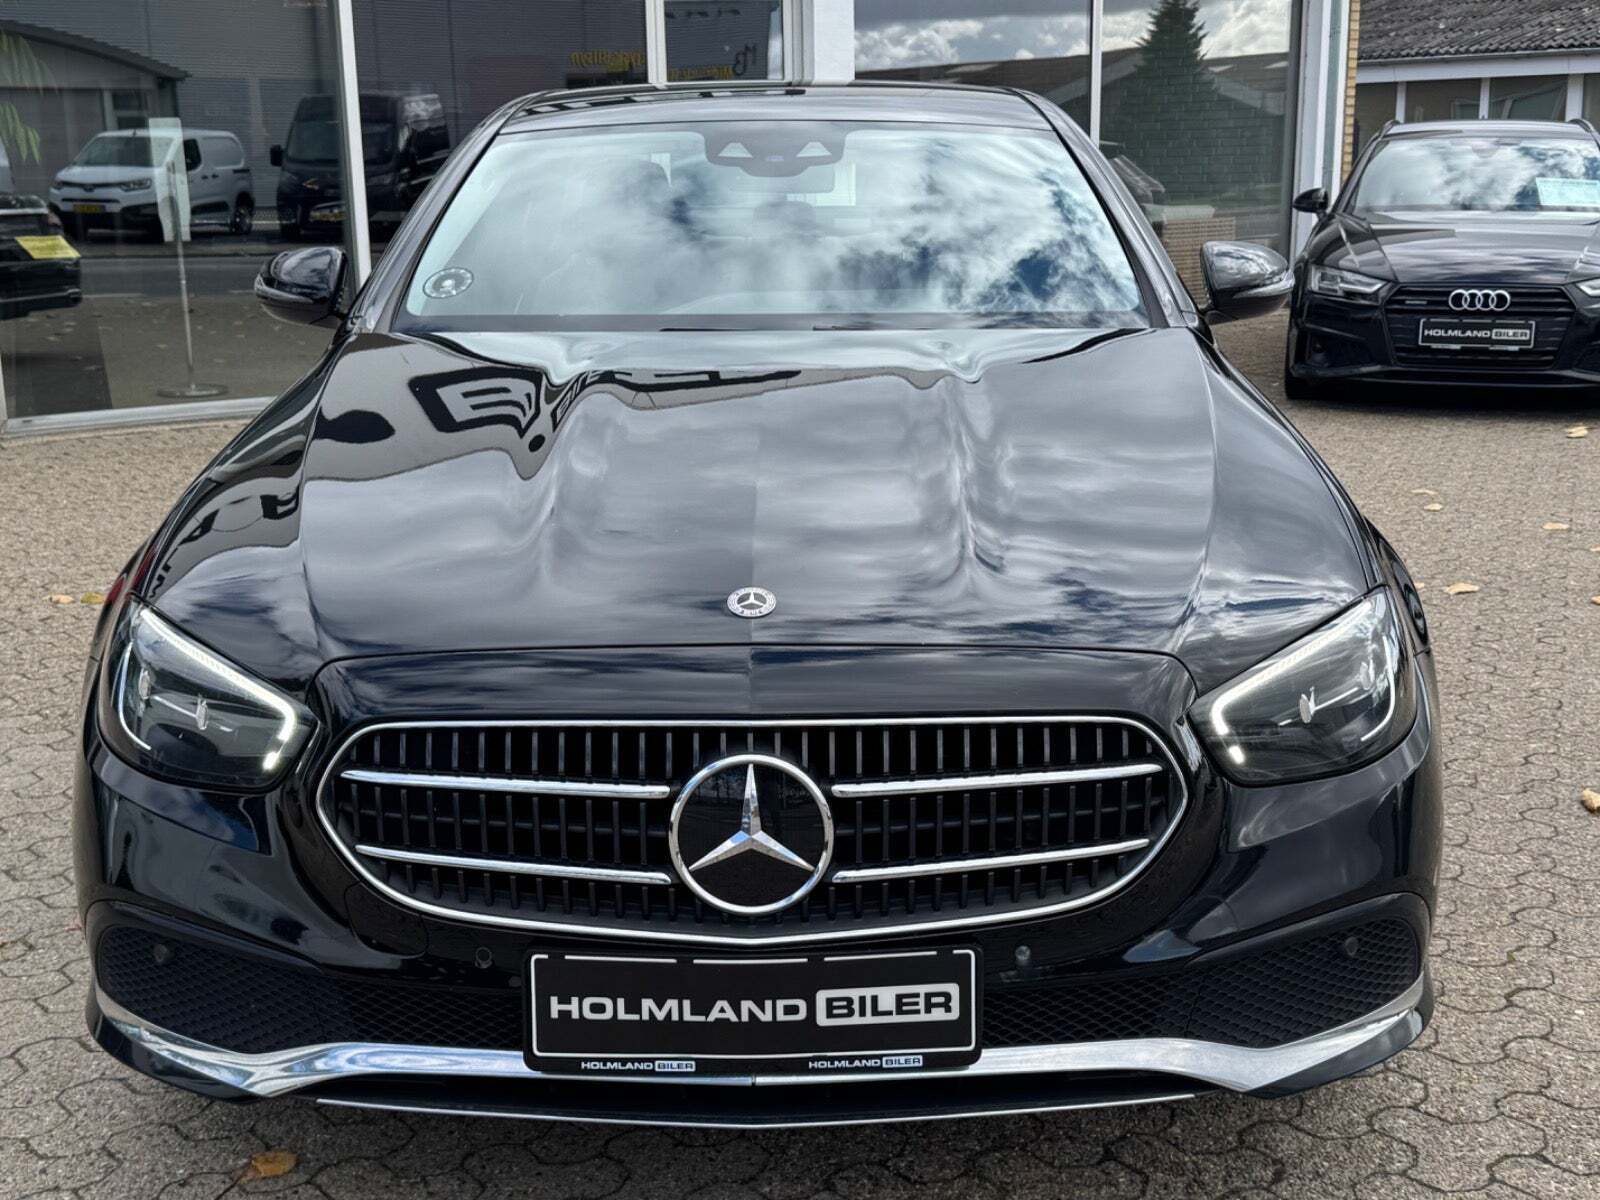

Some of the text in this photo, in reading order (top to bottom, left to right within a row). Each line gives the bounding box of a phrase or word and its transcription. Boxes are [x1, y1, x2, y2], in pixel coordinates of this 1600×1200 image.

[1424, 328, 1490, 338] HOLMLAND
[550, 991, 952, 1022] HOLMLAND BILER
[581, 1061, 693, 1070] HOLMLAND BILER
[809, 1057, 921, 1069] HOLMLAND BILER
